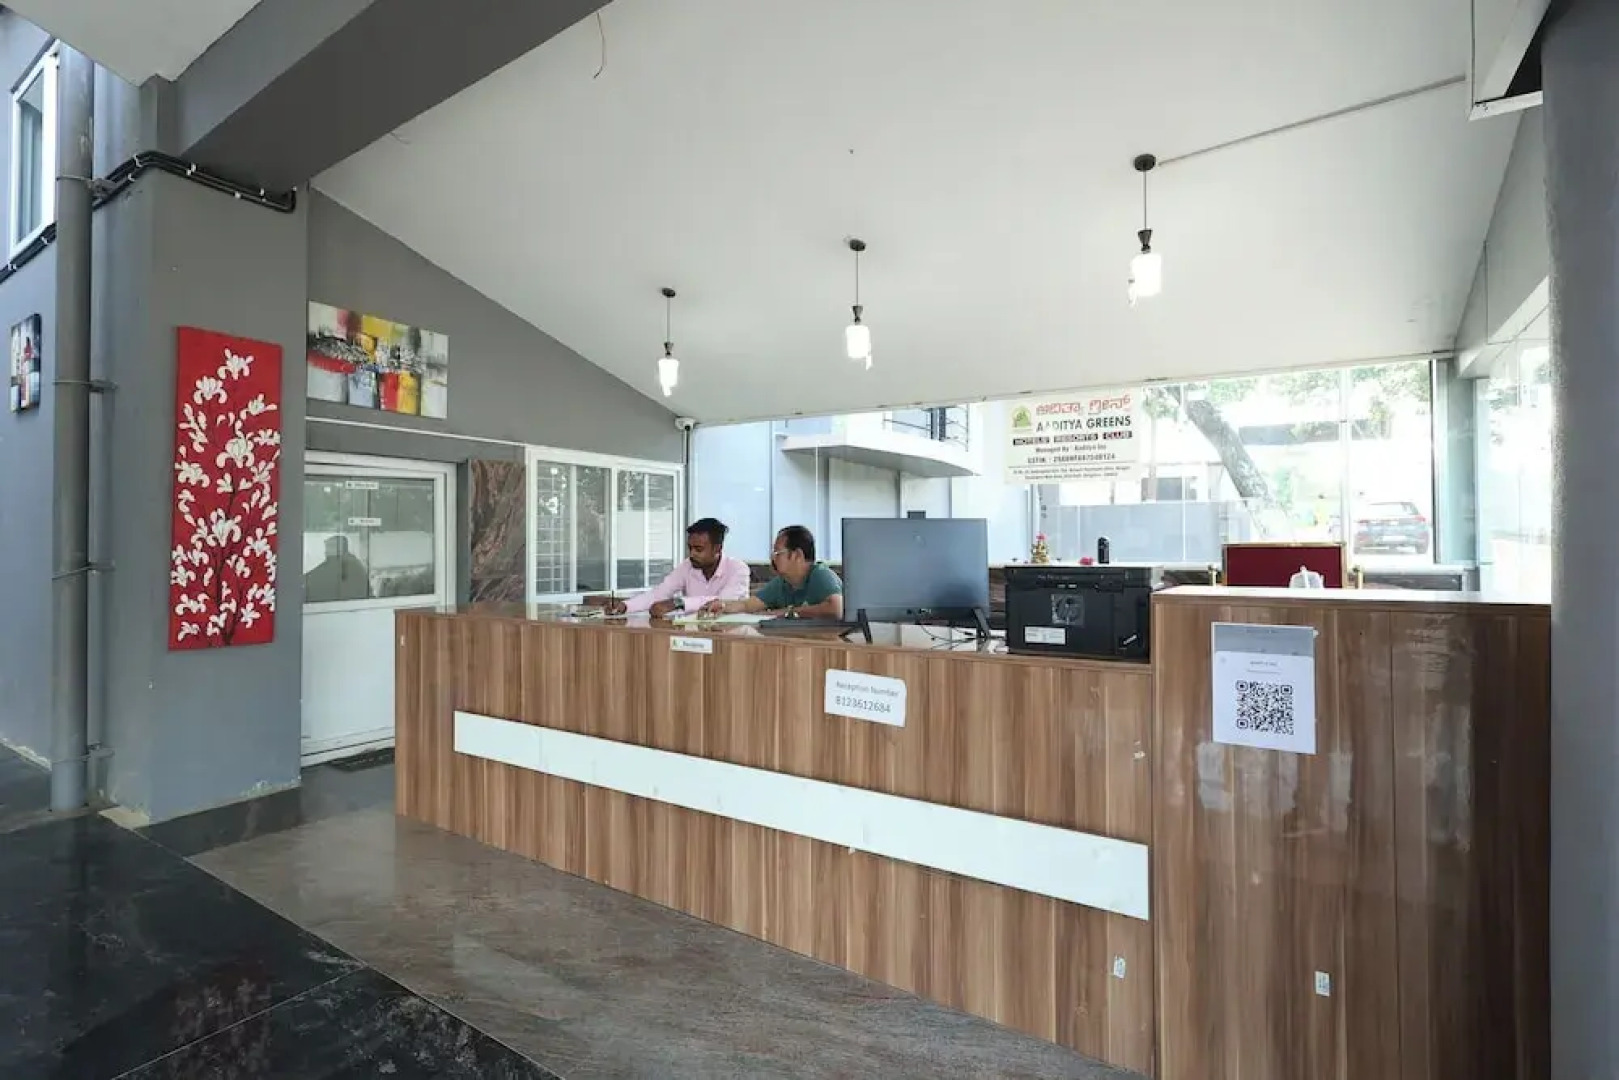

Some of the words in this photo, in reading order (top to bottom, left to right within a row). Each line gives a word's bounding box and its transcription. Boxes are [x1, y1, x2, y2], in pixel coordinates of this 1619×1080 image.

[1036, 419, 1082, 432] AADITYA
[1086, 415, 1131, 428] GREENS
[1103, 431, 1132, 439] CLUB
[836, 680, 869, 692] Reception
[871, 686, 900, 697] Number
